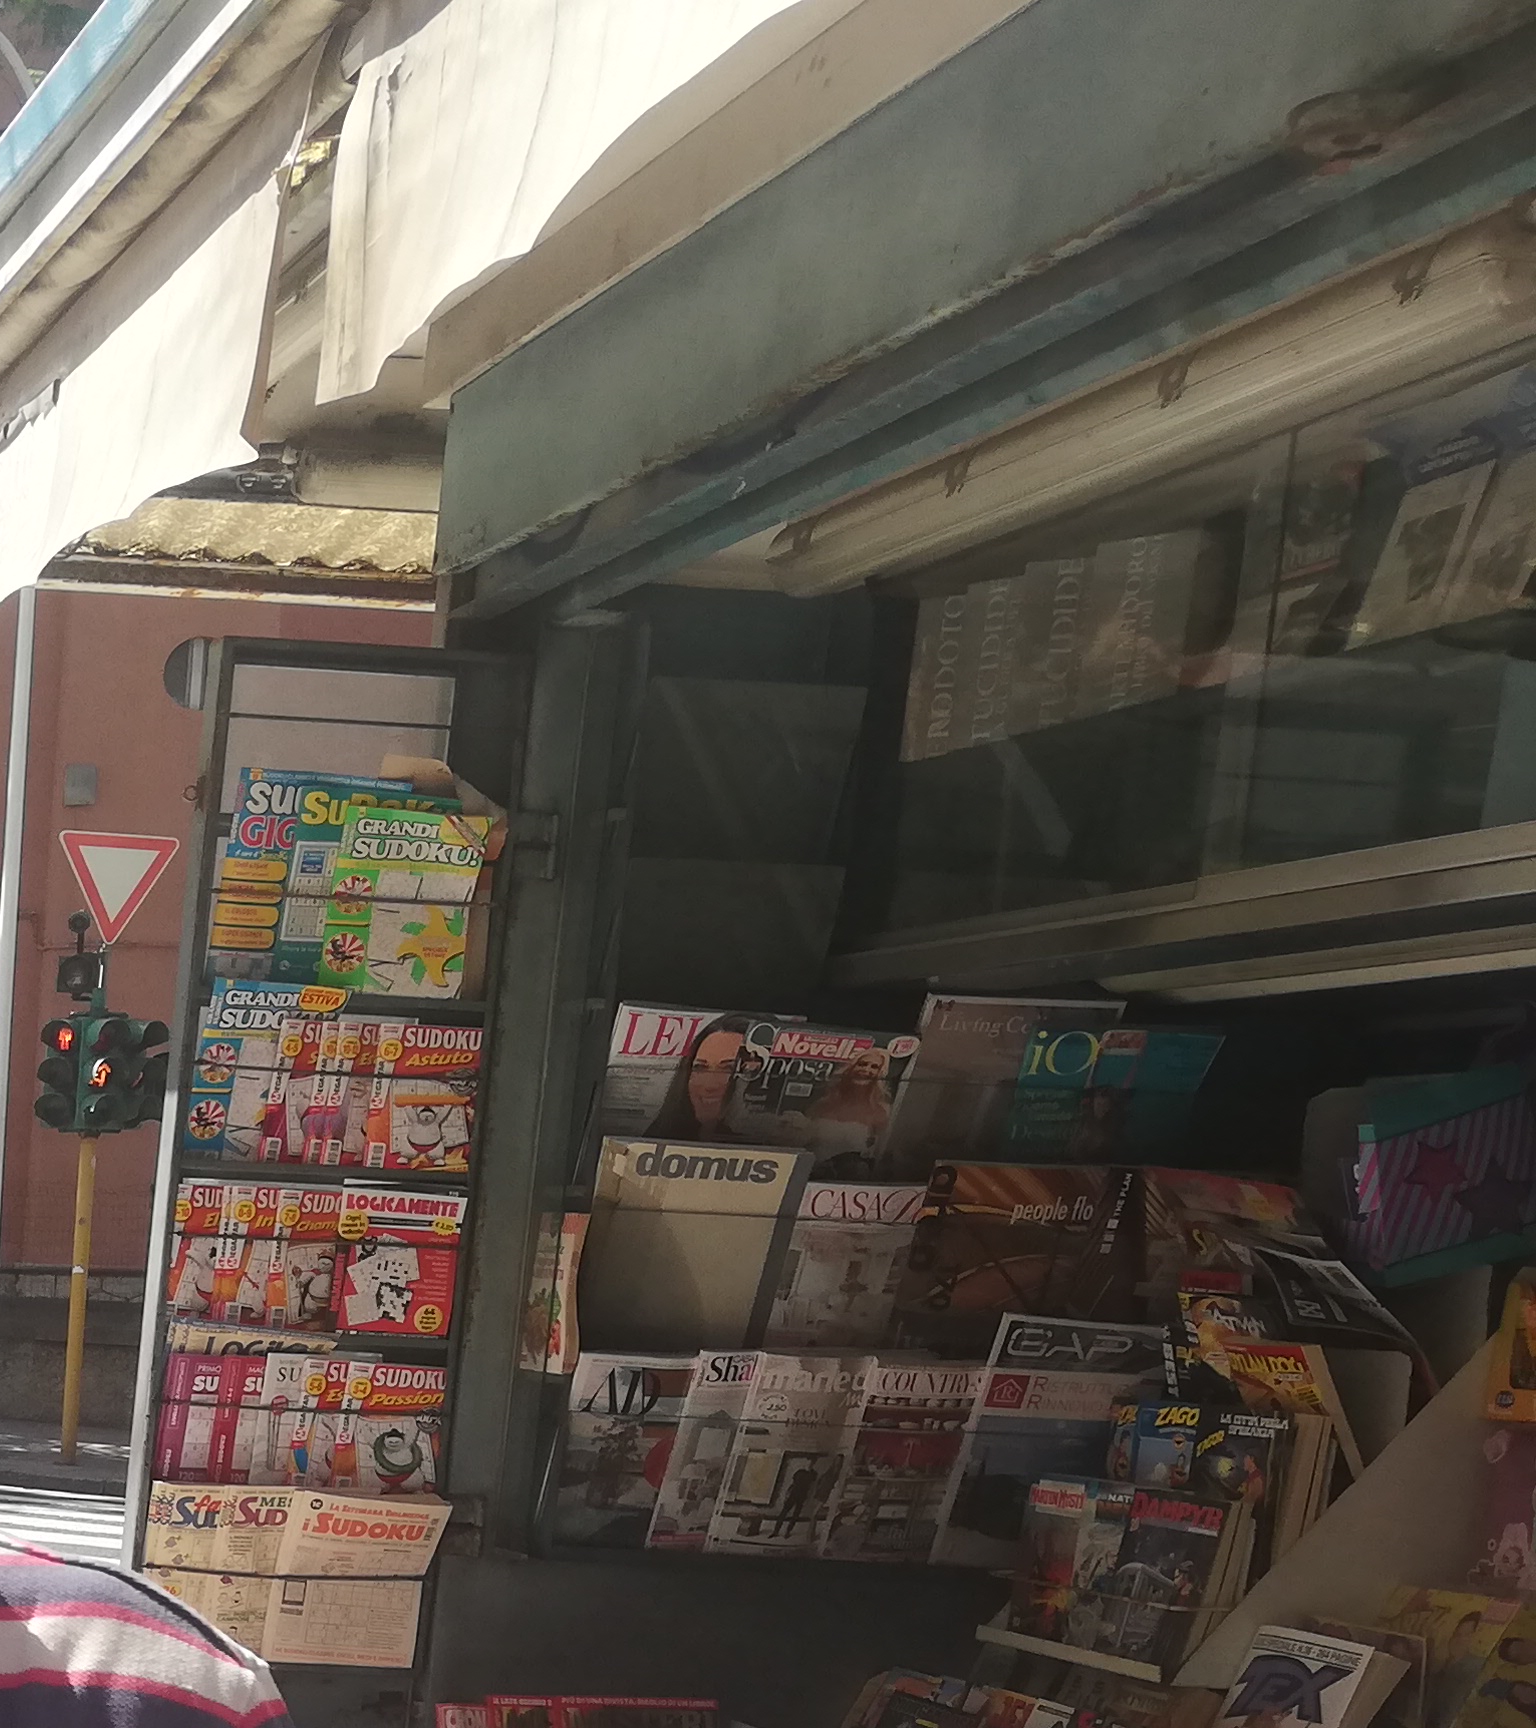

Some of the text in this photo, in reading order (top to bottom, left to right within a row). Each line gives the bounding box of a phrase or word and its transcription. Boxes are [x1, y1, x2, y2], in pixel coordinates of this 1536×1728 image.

[357, 817, 440, 839] GRANDI
[351, 837, 481, 867] SUDOKU!
[301, 992, 342, 1007] ESTIVA
[404, 1027, 483, 1051] SUDOKU
[406, 1051, 474, 1067] Astuto
[635, 1144, 780, 1185] domus
[346, 1193, 460, 1218] LOGICAMENTE
[811, 1189, 882, 1221] CASA
[1010, 1196, 1067, 1226] people
[373, 1368, 446, 1390] SUDOKU
[313, 1512, 426, 1542] SUDOKU
